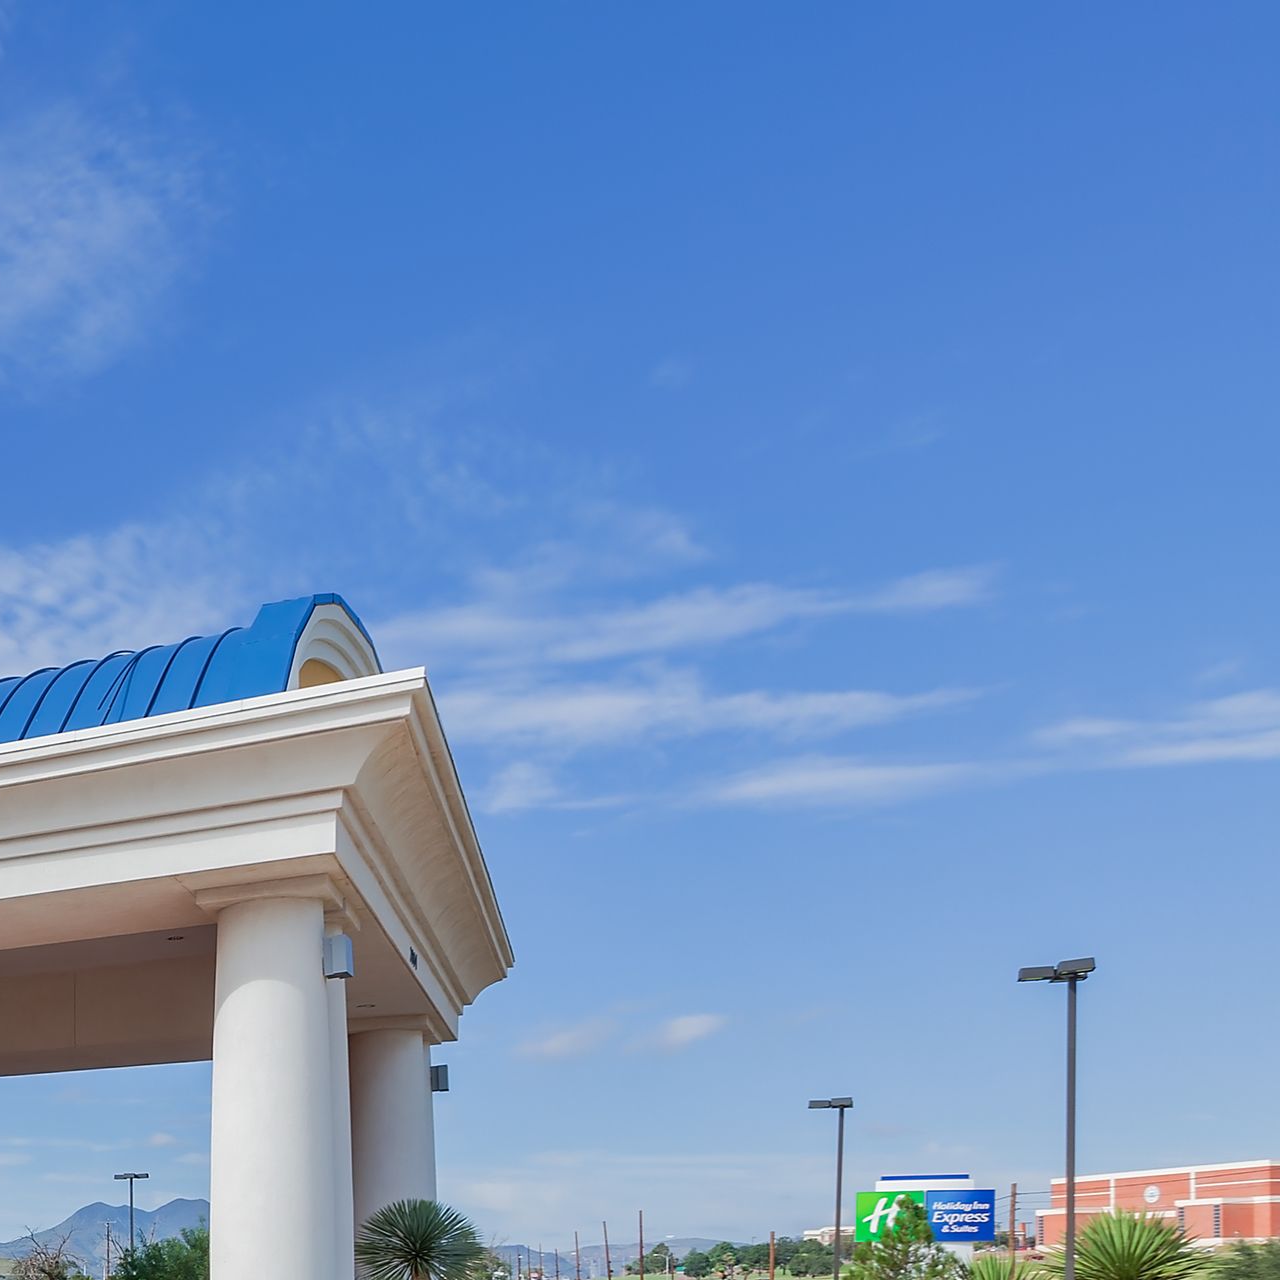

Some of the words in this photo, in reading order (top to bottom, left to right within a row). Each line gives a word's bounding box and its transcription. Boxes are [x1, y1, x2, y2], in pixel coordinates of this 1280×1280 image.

[932, 1201, 972, 1211] Holiday
[973, 1201, 990, 1209] Inn
[932, 1211, 991, 1225] Express
